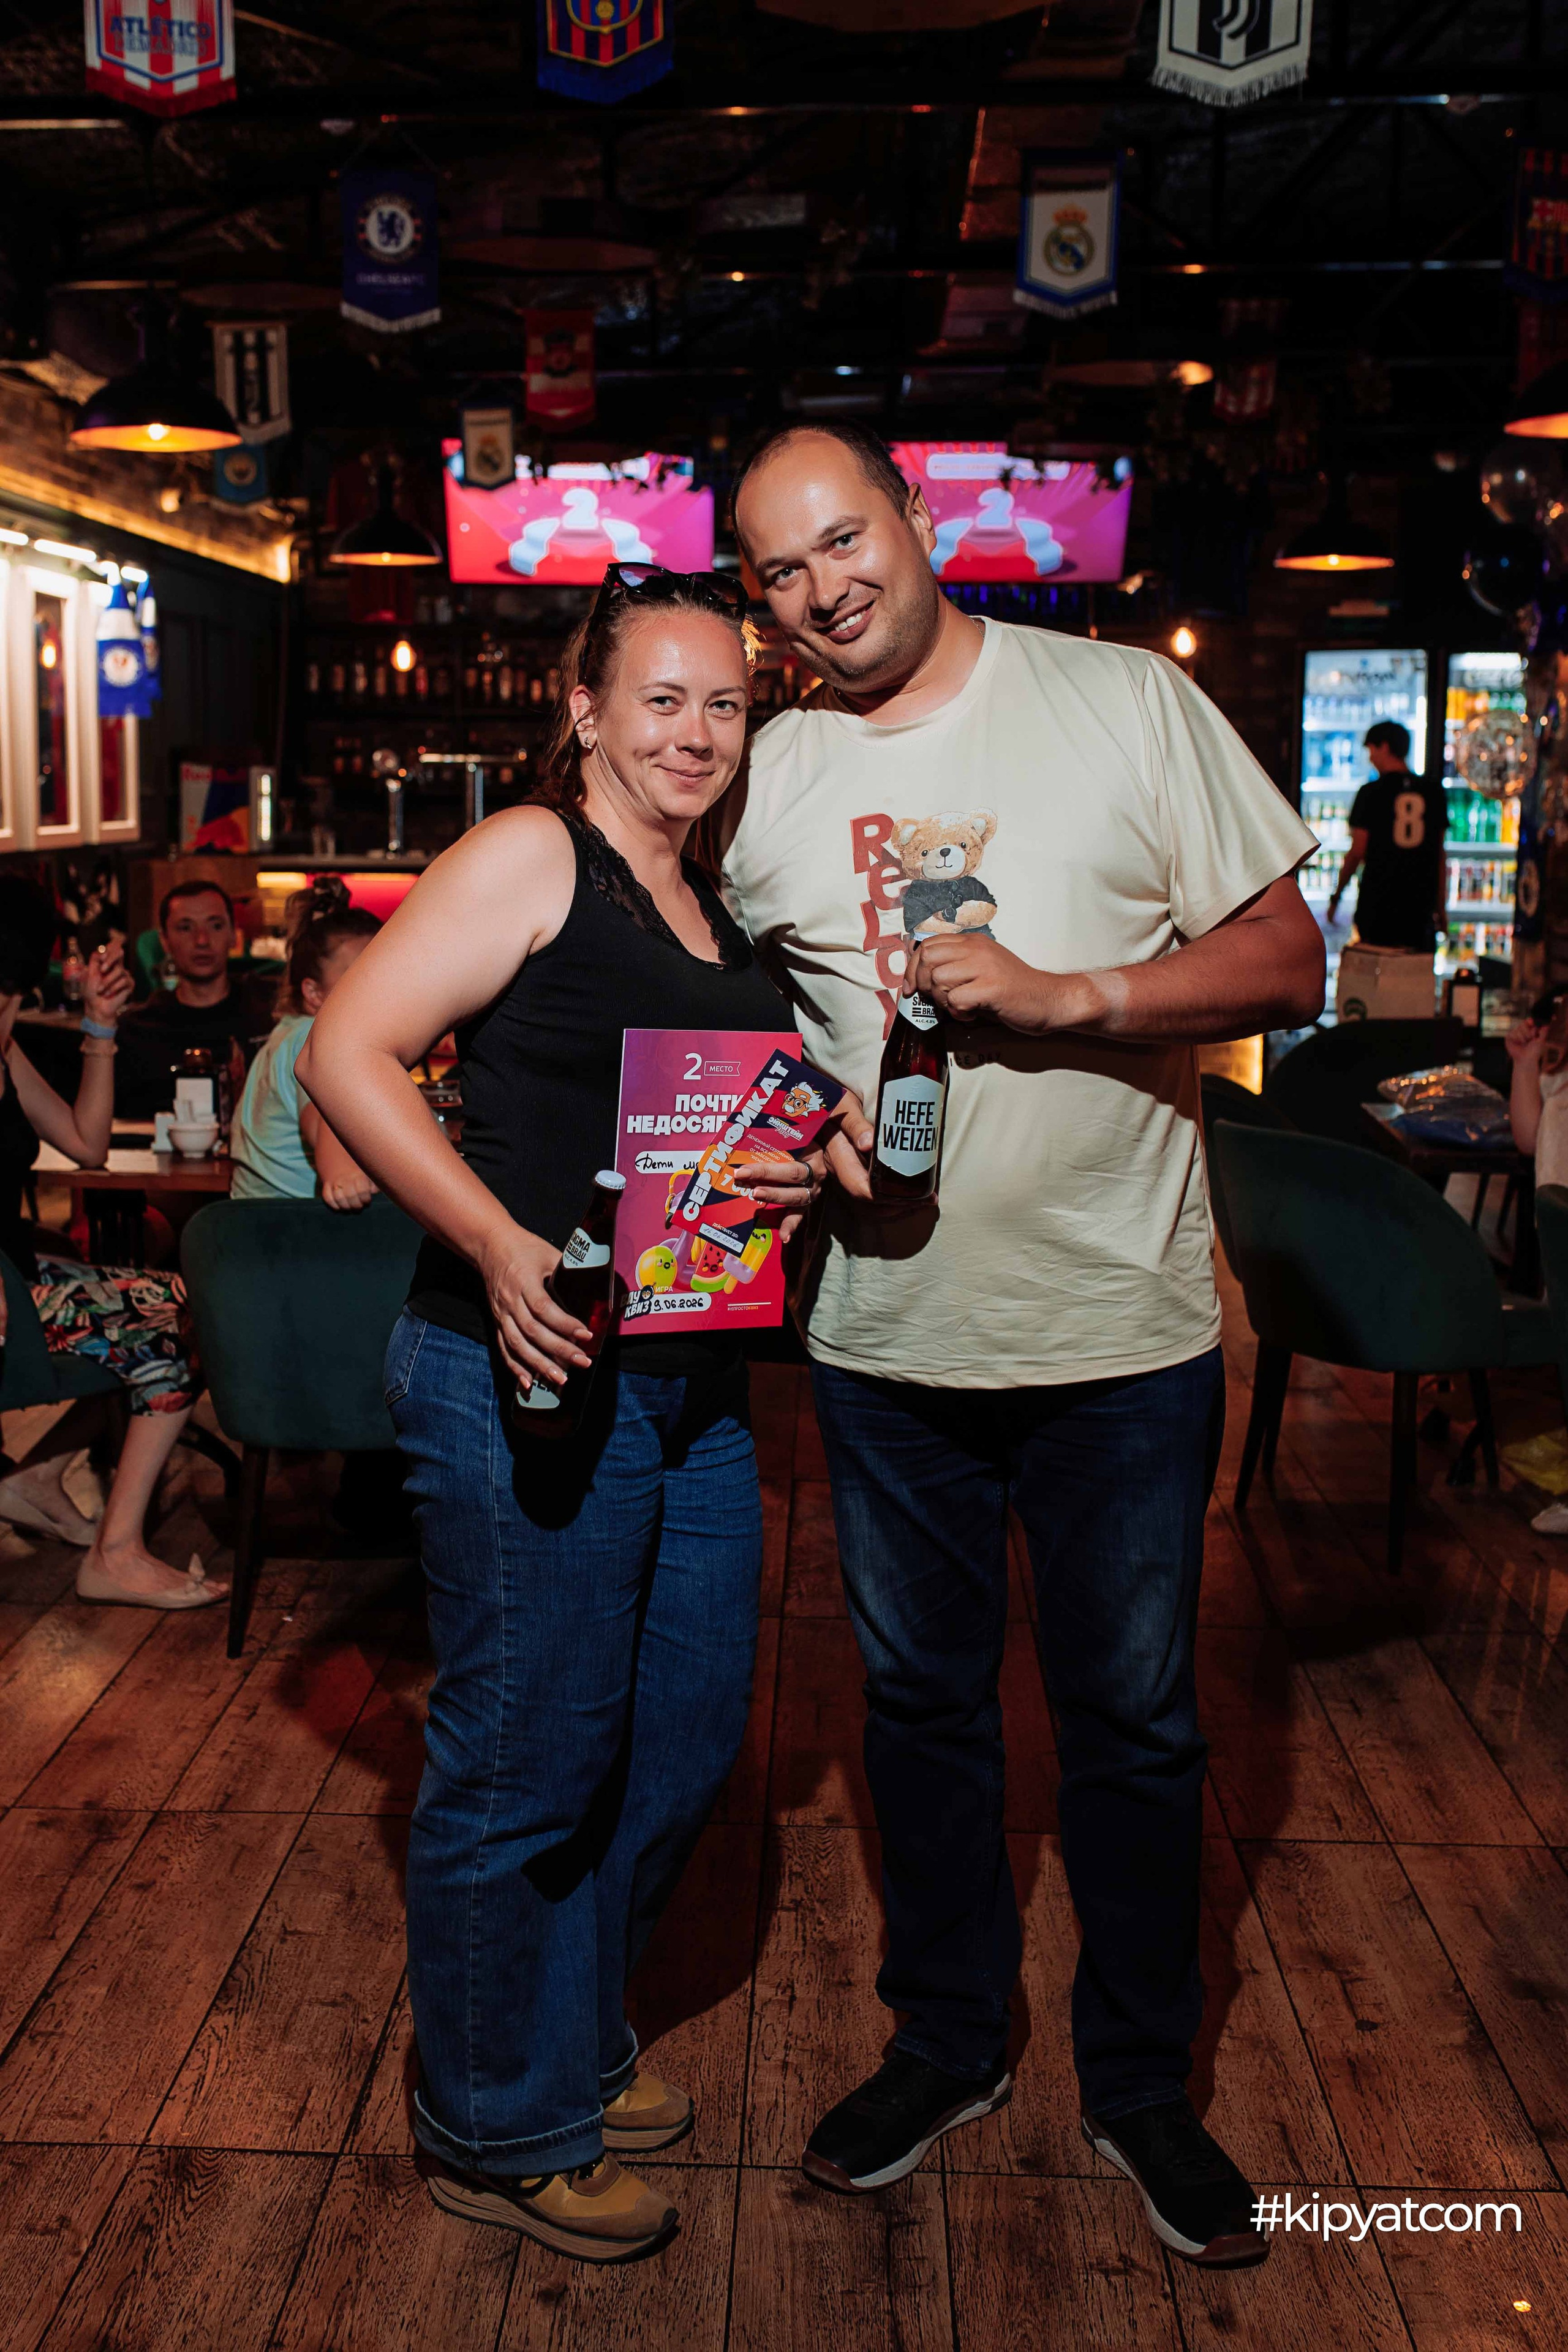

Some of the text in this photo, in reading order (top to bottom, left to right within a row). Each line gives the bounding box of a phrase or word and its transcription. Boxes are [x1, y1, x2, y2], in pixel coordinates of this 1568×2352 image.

[562, 488, 599, 530] 2
[978, 488, 1014, 529] 2
[1392, 792, 1425, 850] 8
[683, 1052, 703, 1080] 2
[894, 1099, 935, 1126] HEFE
[627, 1115, 728, 1136] НЕДОСЯГ
[682, 1059, 789, 1221] СЕРТИФИКАТ
[747, 1134, 771, 1148] ДЕНЕЖНЫЙ
[883, 1123, 938, 1152] WEIZEN
[635, 1153, 674, 1170] Дети
[755, 1150, 777, 1163] ЗАВЕДЕНИ
[767, 1151, 780, 1161] МЕНЮ
[720, 1172, 733, 1186] 7
[712, 1222, 733, 1235] ДЕЙСТВУЕТ
[571, 1231, 590, 1253] SIGMA
[624, 1300, 650, 1318] КВИЗ
[653, 1298, 704, 1311] 9.06.2026
